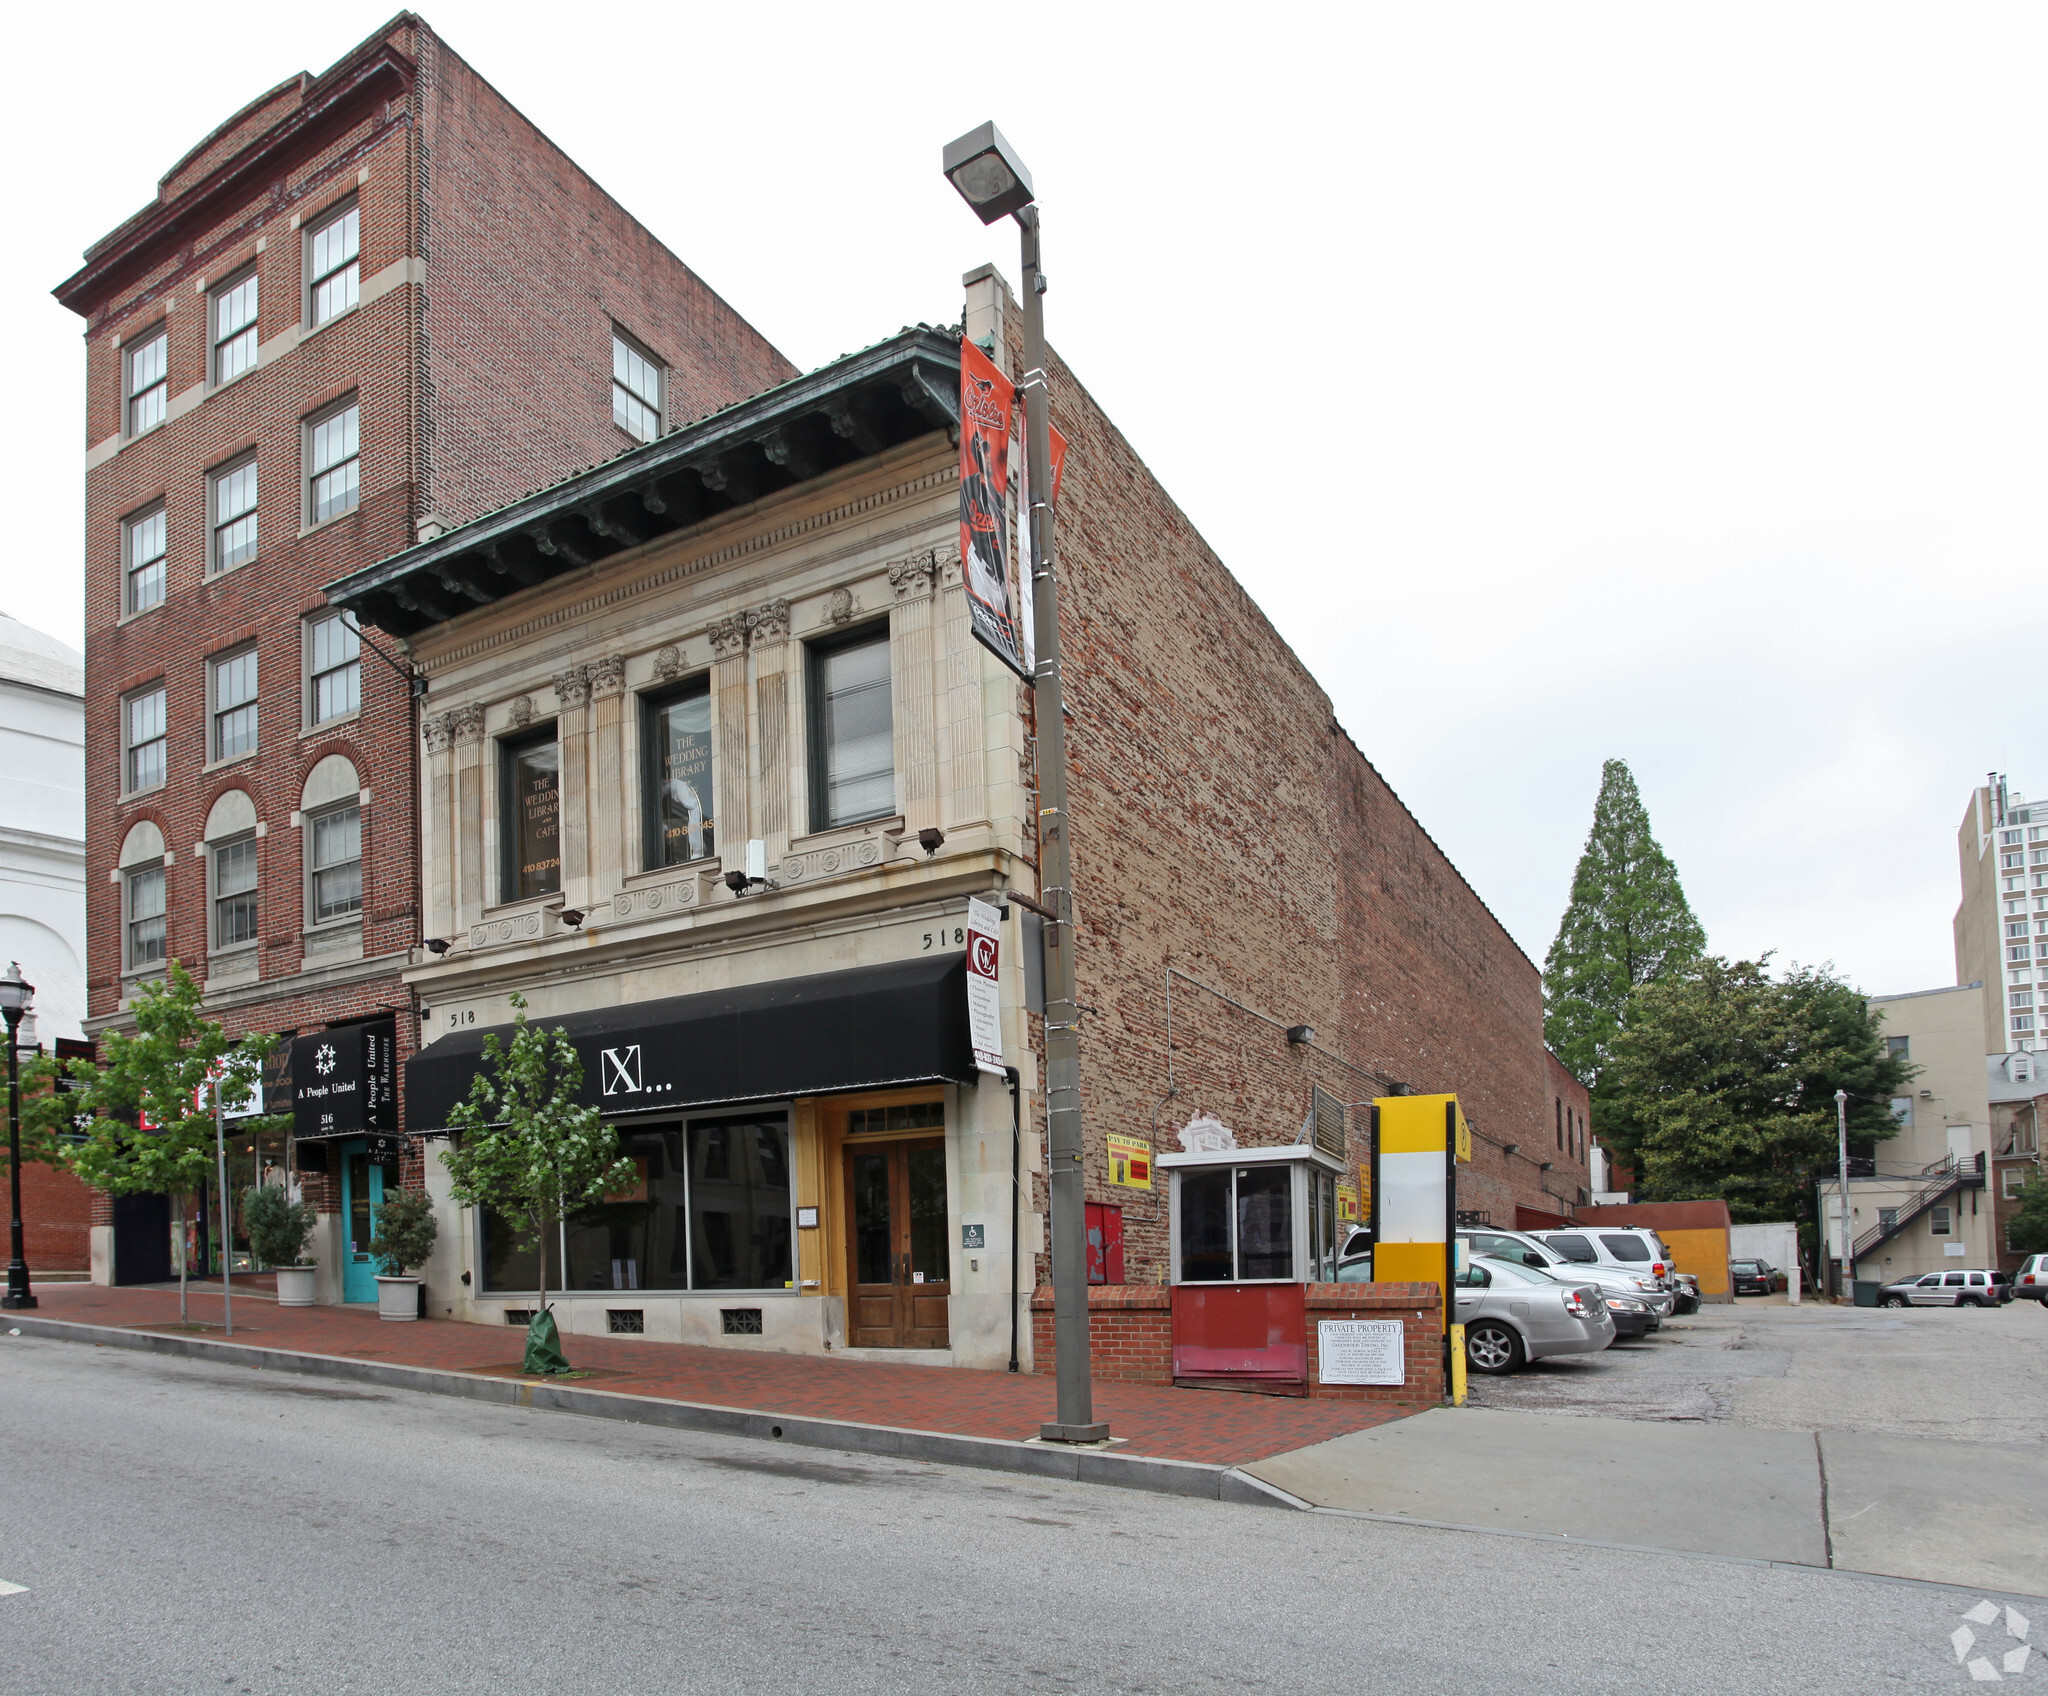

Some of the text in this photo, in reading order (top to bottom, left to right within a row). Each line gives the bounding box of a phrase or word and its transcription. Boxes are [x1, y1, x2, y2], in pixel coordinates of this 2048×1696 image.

[964, 383, 1005, 430] Orioles
[675, 735, 695, 750] THE
[664, 745, 708, 767] WEDDING
[665, 760, 707, 782] LIBRARY
[533, 778, 550, 791] THE
[922, 927, 964, 950] 518
[450, 1010, 475, 1027] 518
[367, 1034, 378, 1124] A People United
[380, 1037, 390, 1102] THE WAREHOUSE
[298, 1080, 356, 1099] A People United
[320, 1113, 334, 1124] 516
[1108, 1135, 1120, 1143] PAY
[1132, 1141, 1149, 1149] PARK
[1324, 1324, 1397, 1333] PRIVATE PROPERTY
